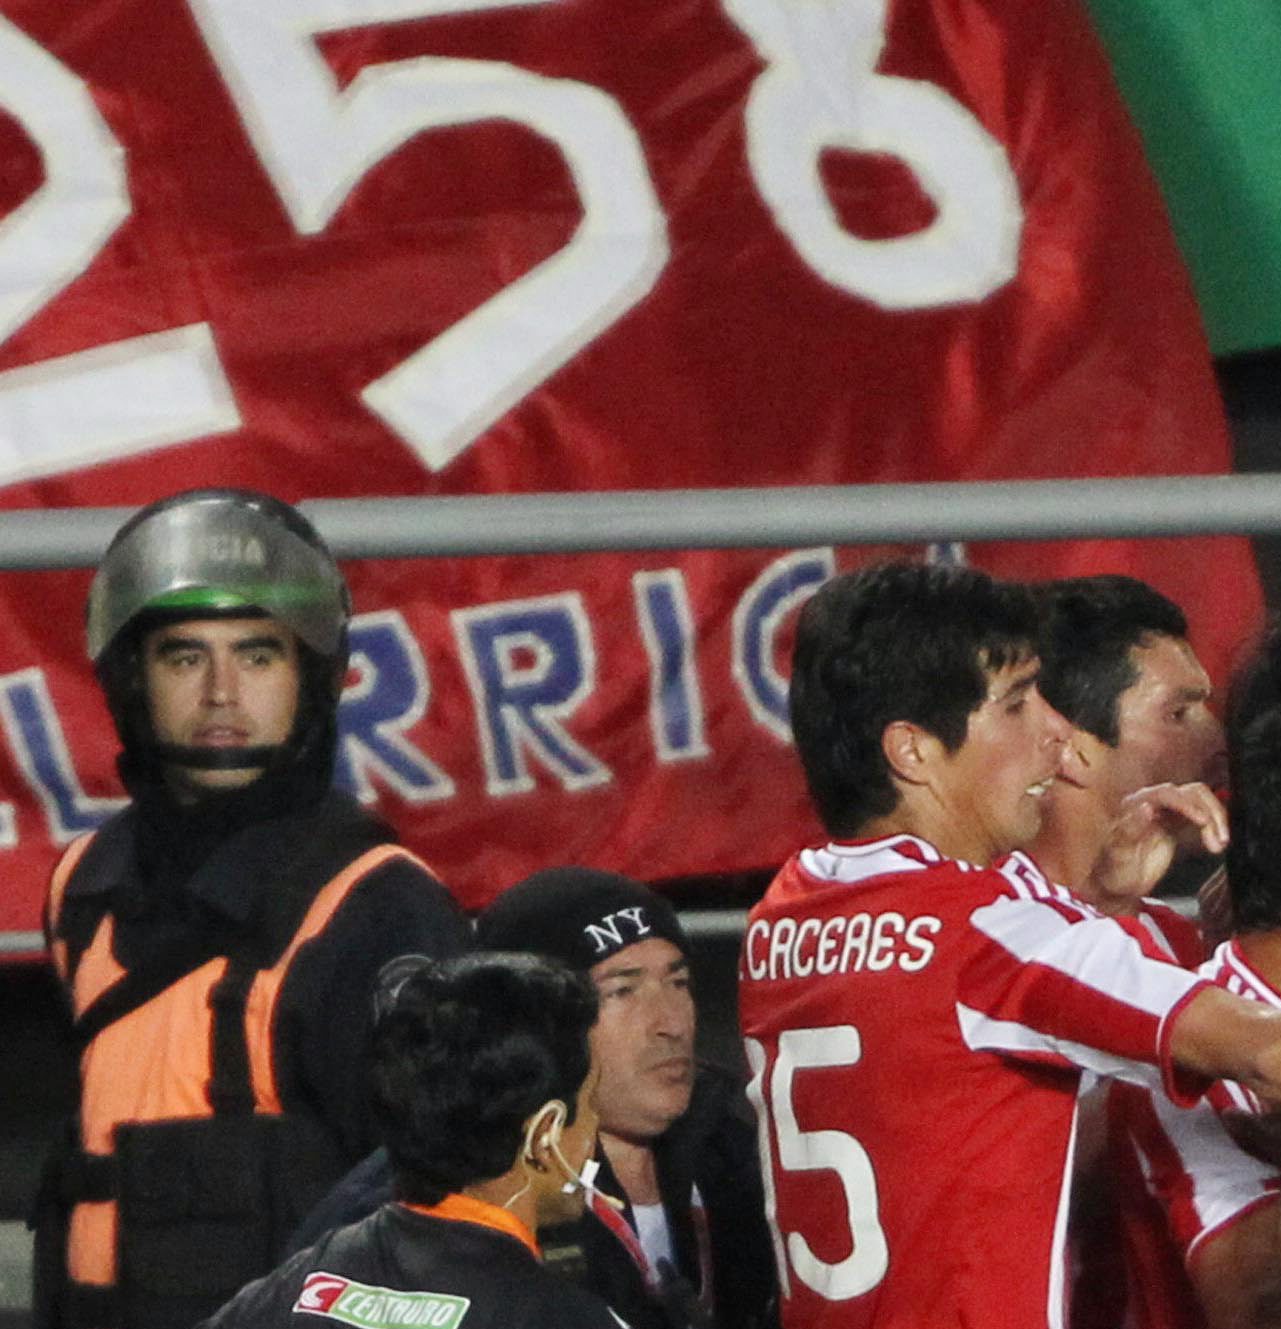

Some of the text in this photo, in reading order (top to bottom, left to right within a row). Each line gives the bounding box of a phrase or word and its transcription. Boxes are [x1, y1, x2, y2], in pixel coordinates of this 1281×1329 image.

[584, 907, 651, 953] NY
[746, 912, 942, 982] CACERES
[338, 1290, 458, 1328] CENTAURO
